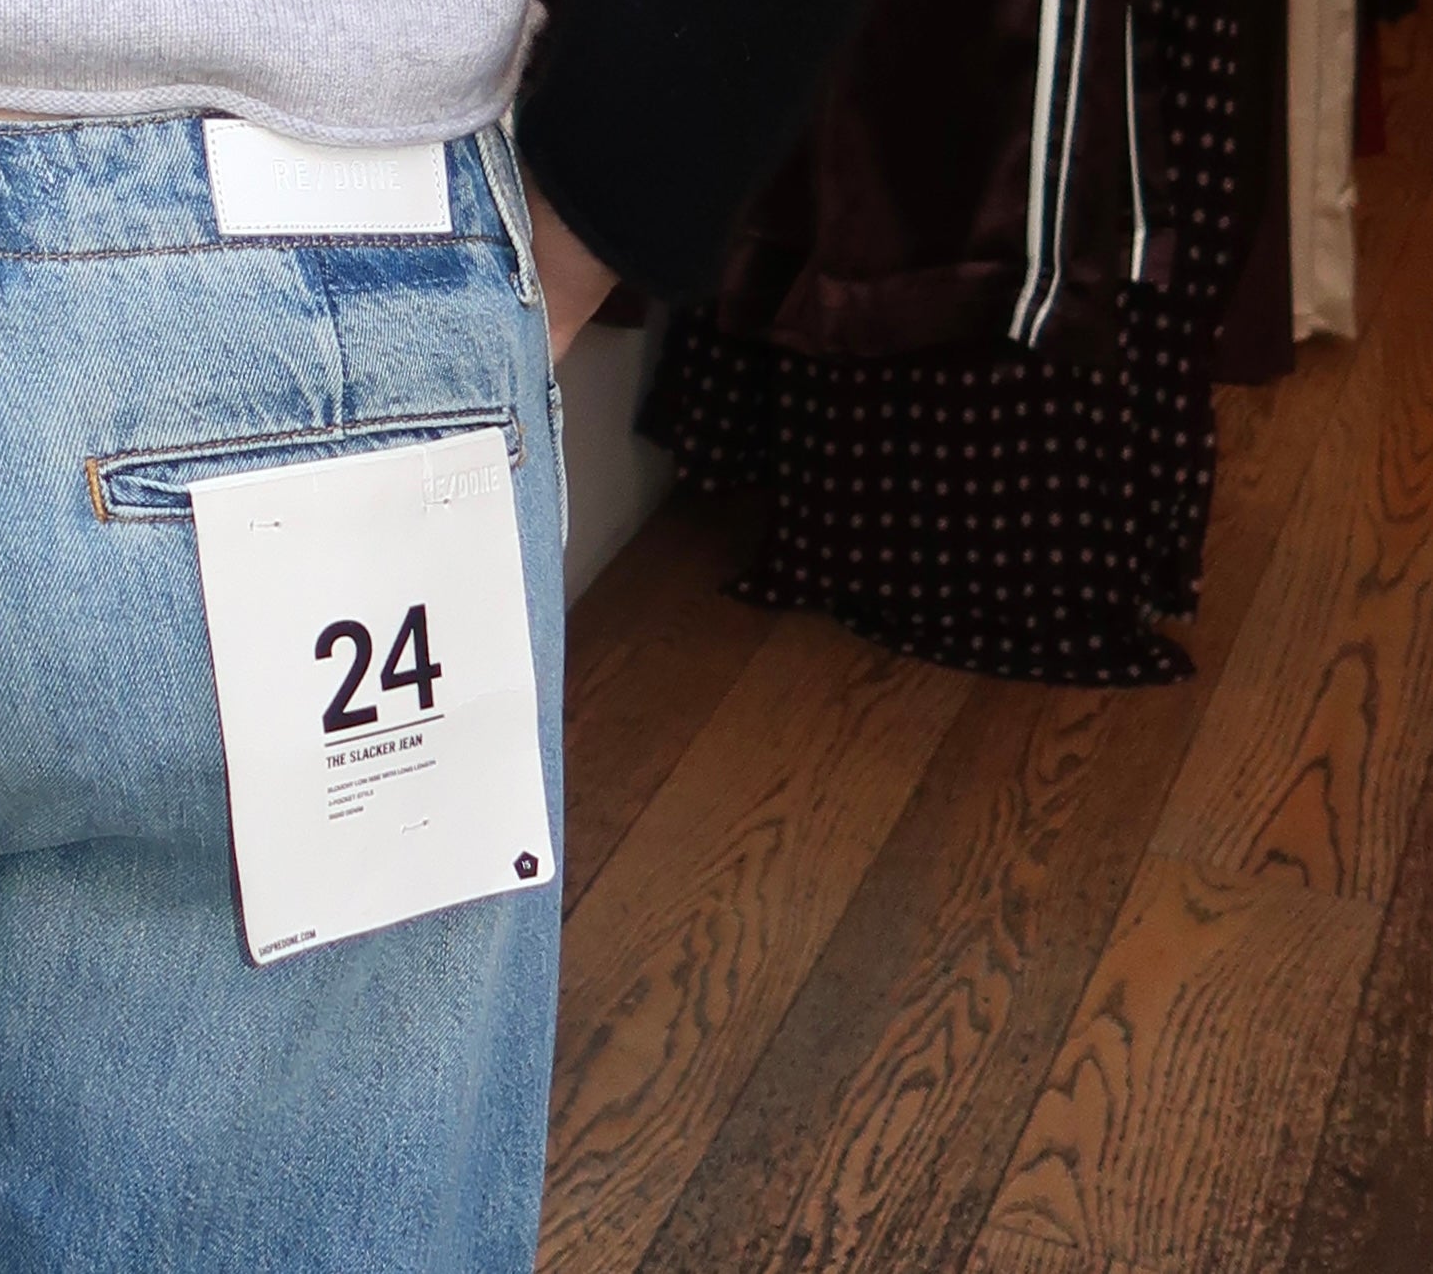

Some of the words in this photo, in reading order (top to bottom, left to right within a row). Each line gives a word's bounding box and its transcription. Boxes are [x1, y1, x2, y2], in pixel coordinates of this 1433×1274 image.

[271, 157, 403, 191] RE/DONE
[314, 604, 442, 733] 24
[326, 753, 346, 769] THE
[350, 741, 396, 763] SLACKER
[399, 733, 423, 751] JEAN
